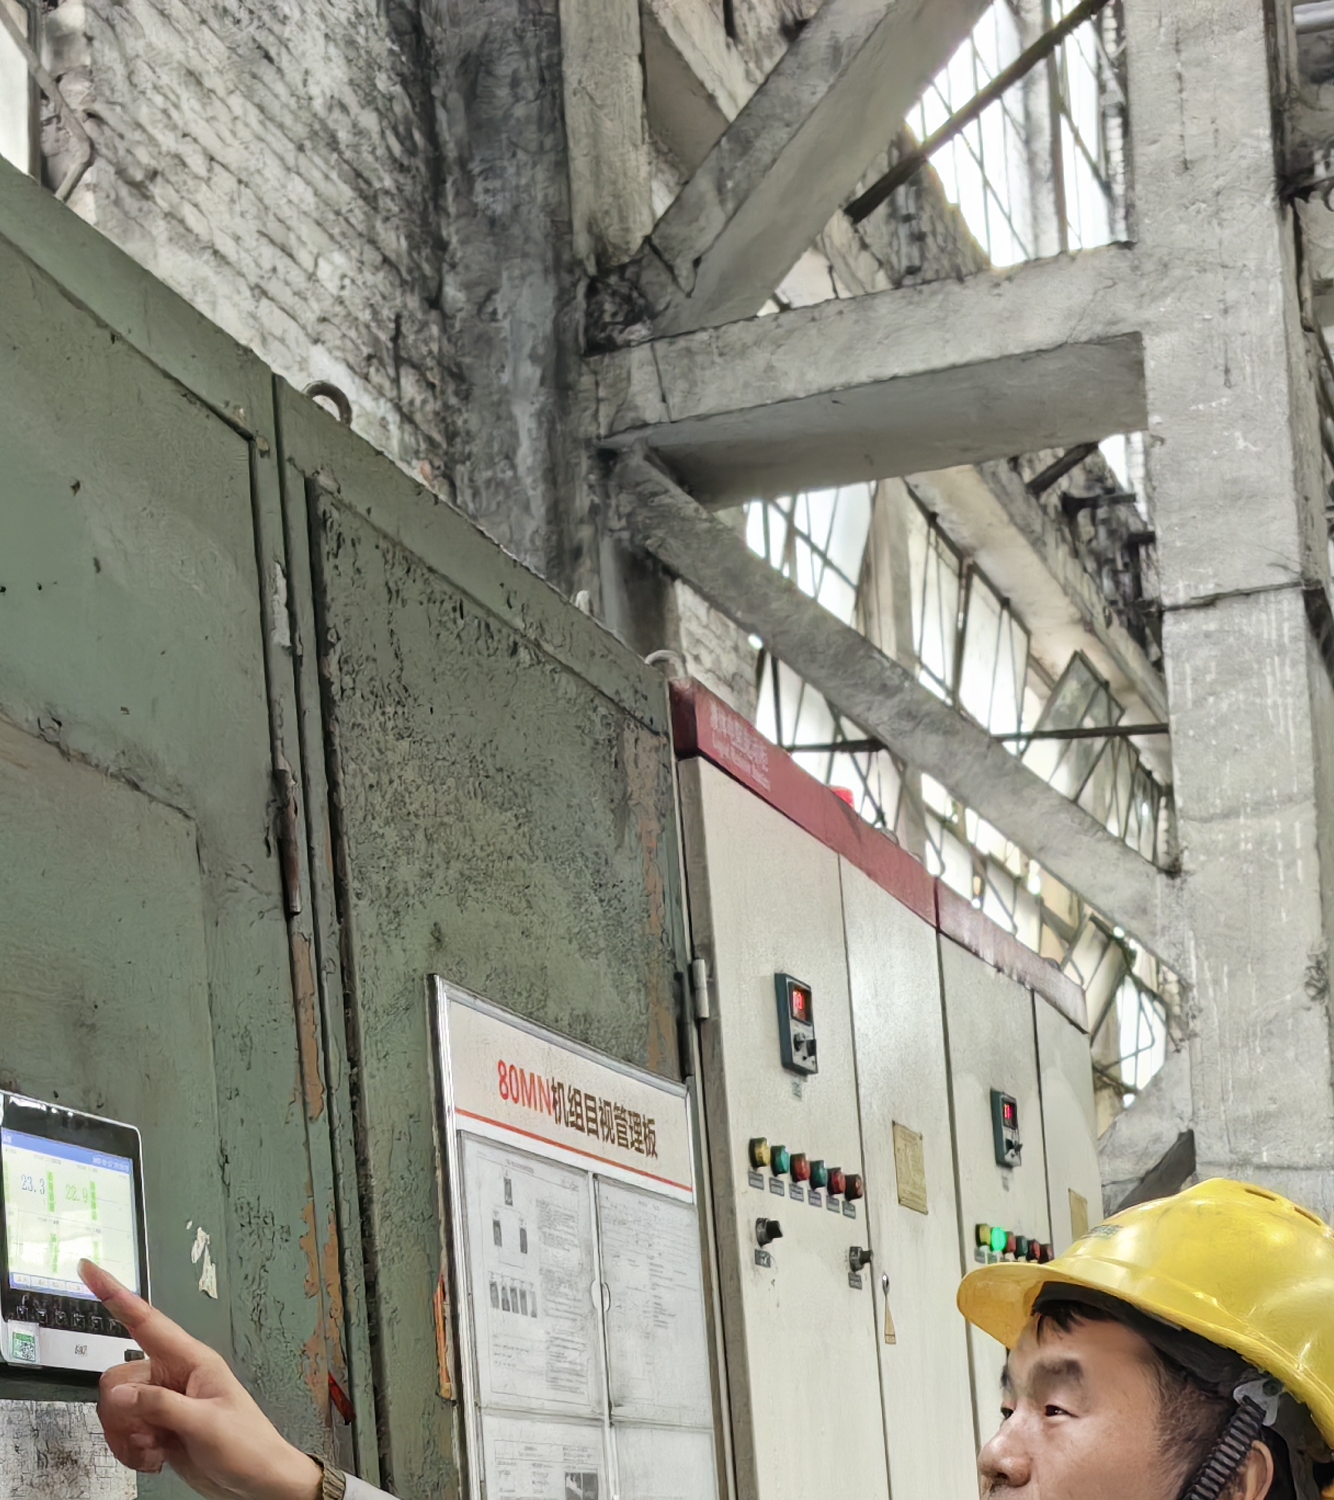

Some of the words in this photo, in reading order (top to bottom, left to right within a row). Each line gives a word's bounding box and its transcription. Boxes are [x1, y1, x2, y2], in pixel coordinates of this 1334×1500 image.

[498, 1059, 658, 1160] 80MN机组目视管理板
[20, 1174, 46, 1195] 23.3
